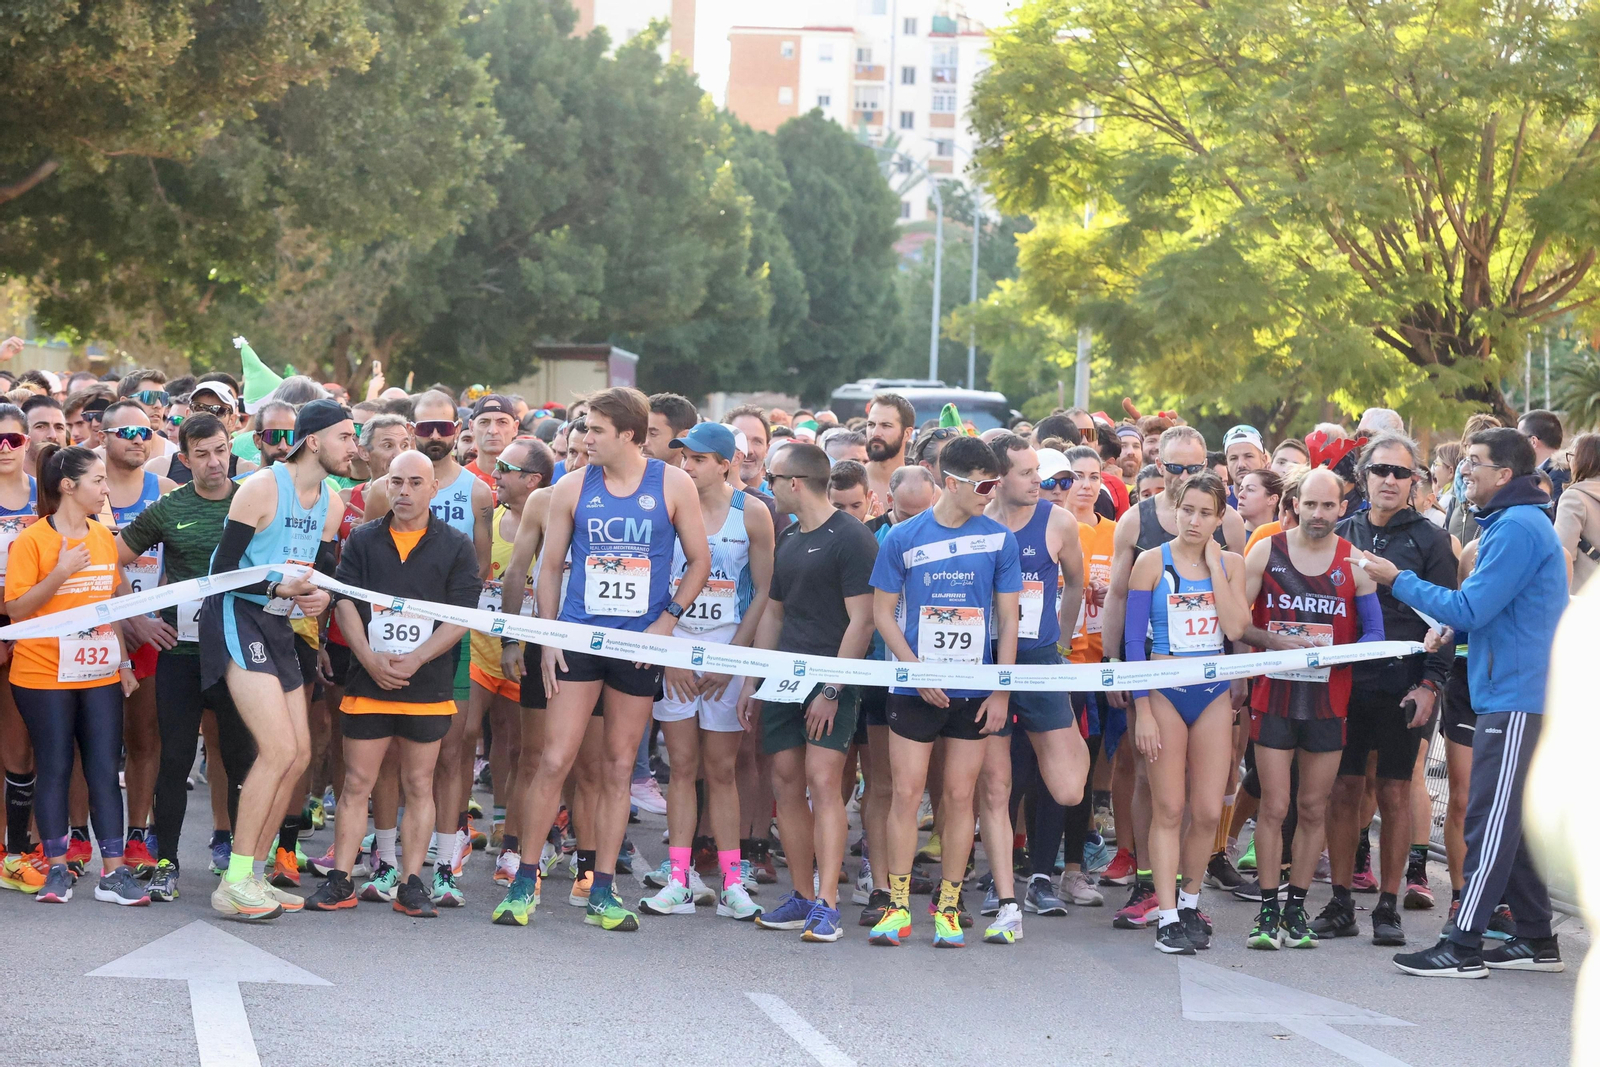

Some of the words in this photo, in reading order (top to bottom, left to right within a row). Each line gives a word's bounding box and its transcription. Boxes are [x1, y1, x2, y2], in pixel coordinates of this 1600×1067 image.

[284, 516, 318, 533] nerja
[588, 517, 652, 543] RCM
[932, 570, 974, 580] ortodent
[598, 581, 636, 600] 215
[407, 604, 441, 618] Ayuntamiento
[686, 602, 722, 620] 216
[383, 623, 421, 642] 369
[507, 625, 541, 635] Ayuntamiento
[1185, 616, 1219, 636] 127
[606, 639, 640, 648] Ayuntamiento
[649, 645, 668, 653] Málaga
[934, 631, 972, 650] 379
[74, 647, 109, 665] 432
[706, 655, 741, 664] Ayuntamiento
[776, 680, 801, 693] 94
